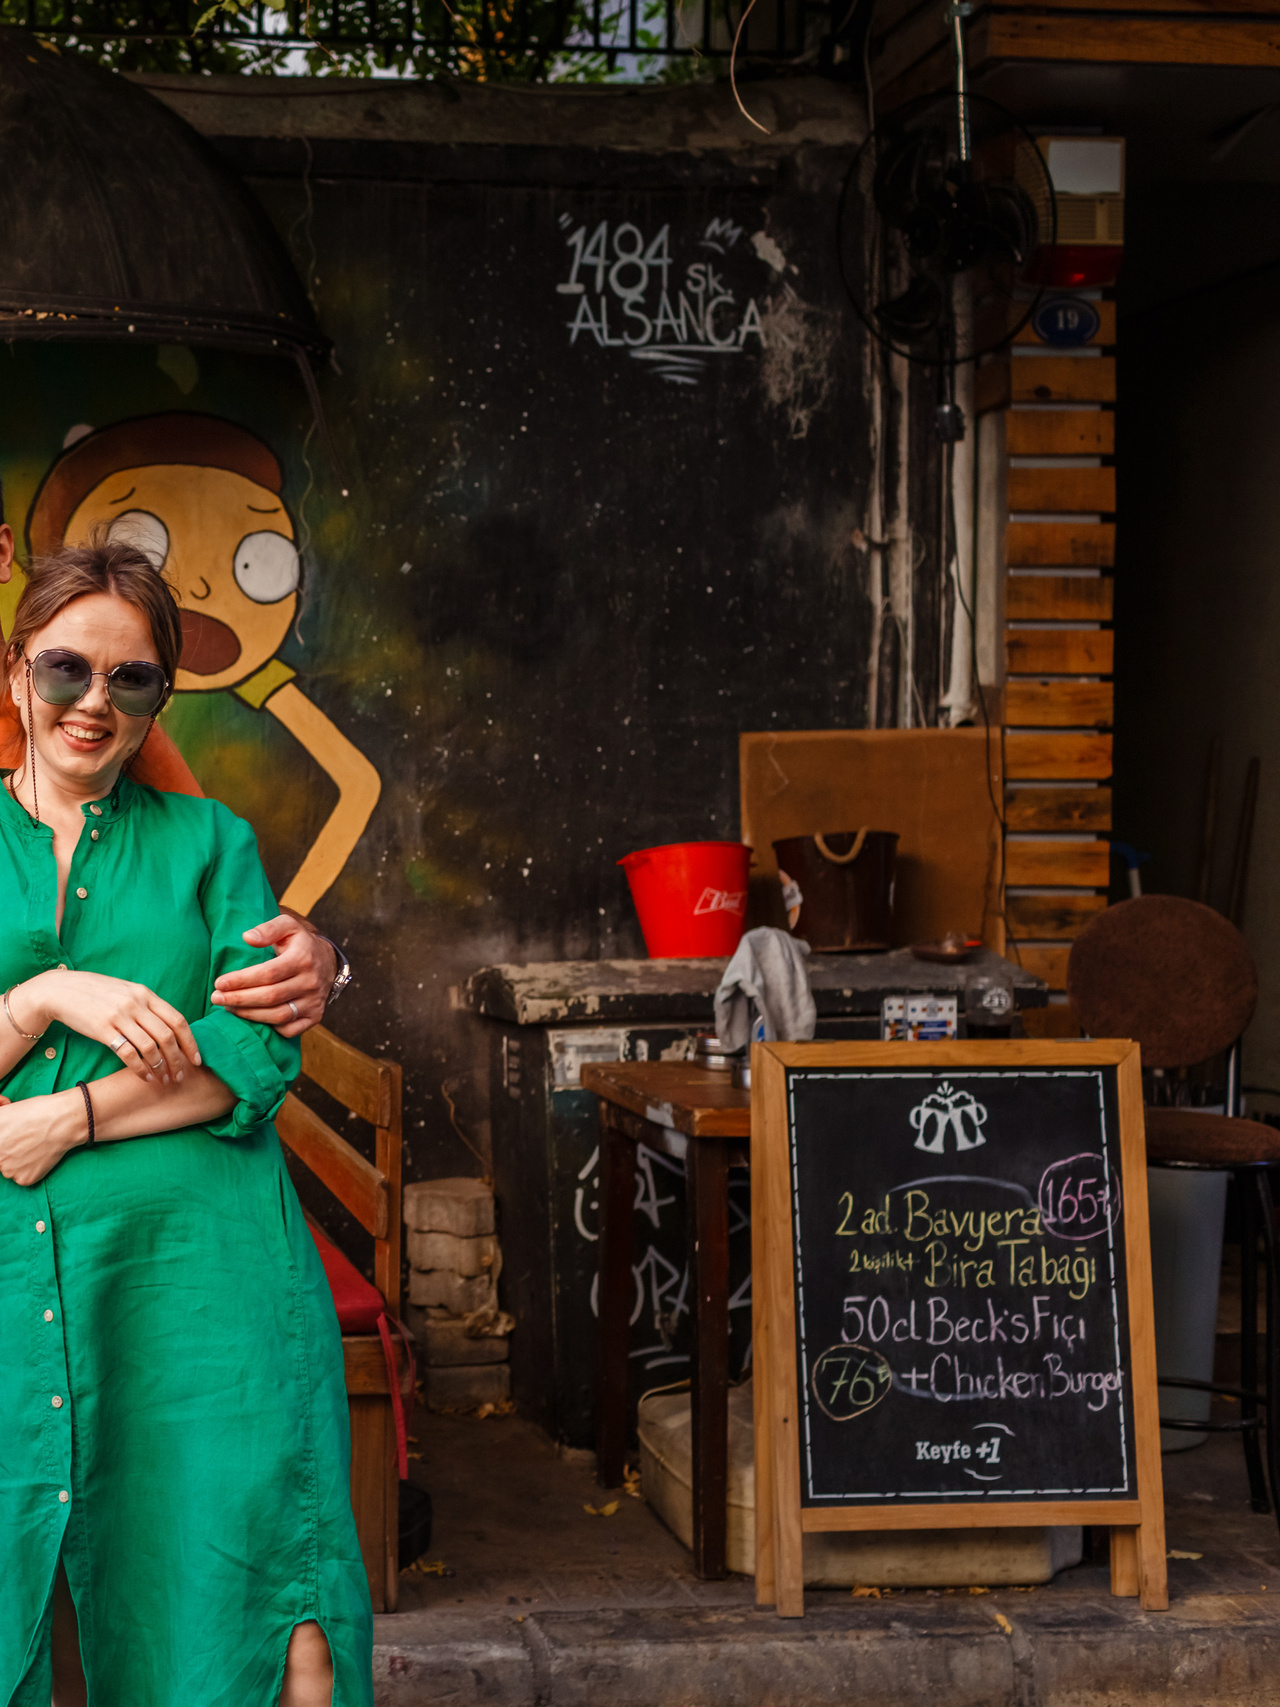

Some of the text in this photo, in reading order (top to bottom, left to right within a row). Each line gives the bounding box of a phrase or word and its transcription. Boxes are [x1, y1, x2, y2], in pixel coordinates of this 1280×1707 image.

[556, 220, 673, 298] 1484
[1057, 309, 1080, 331] 19
[904, 1190, 1045, 1251] Bavyera
[924, 1240, 995, 1288] Bira
[915, 1441, 971, 1464] Keyfe
